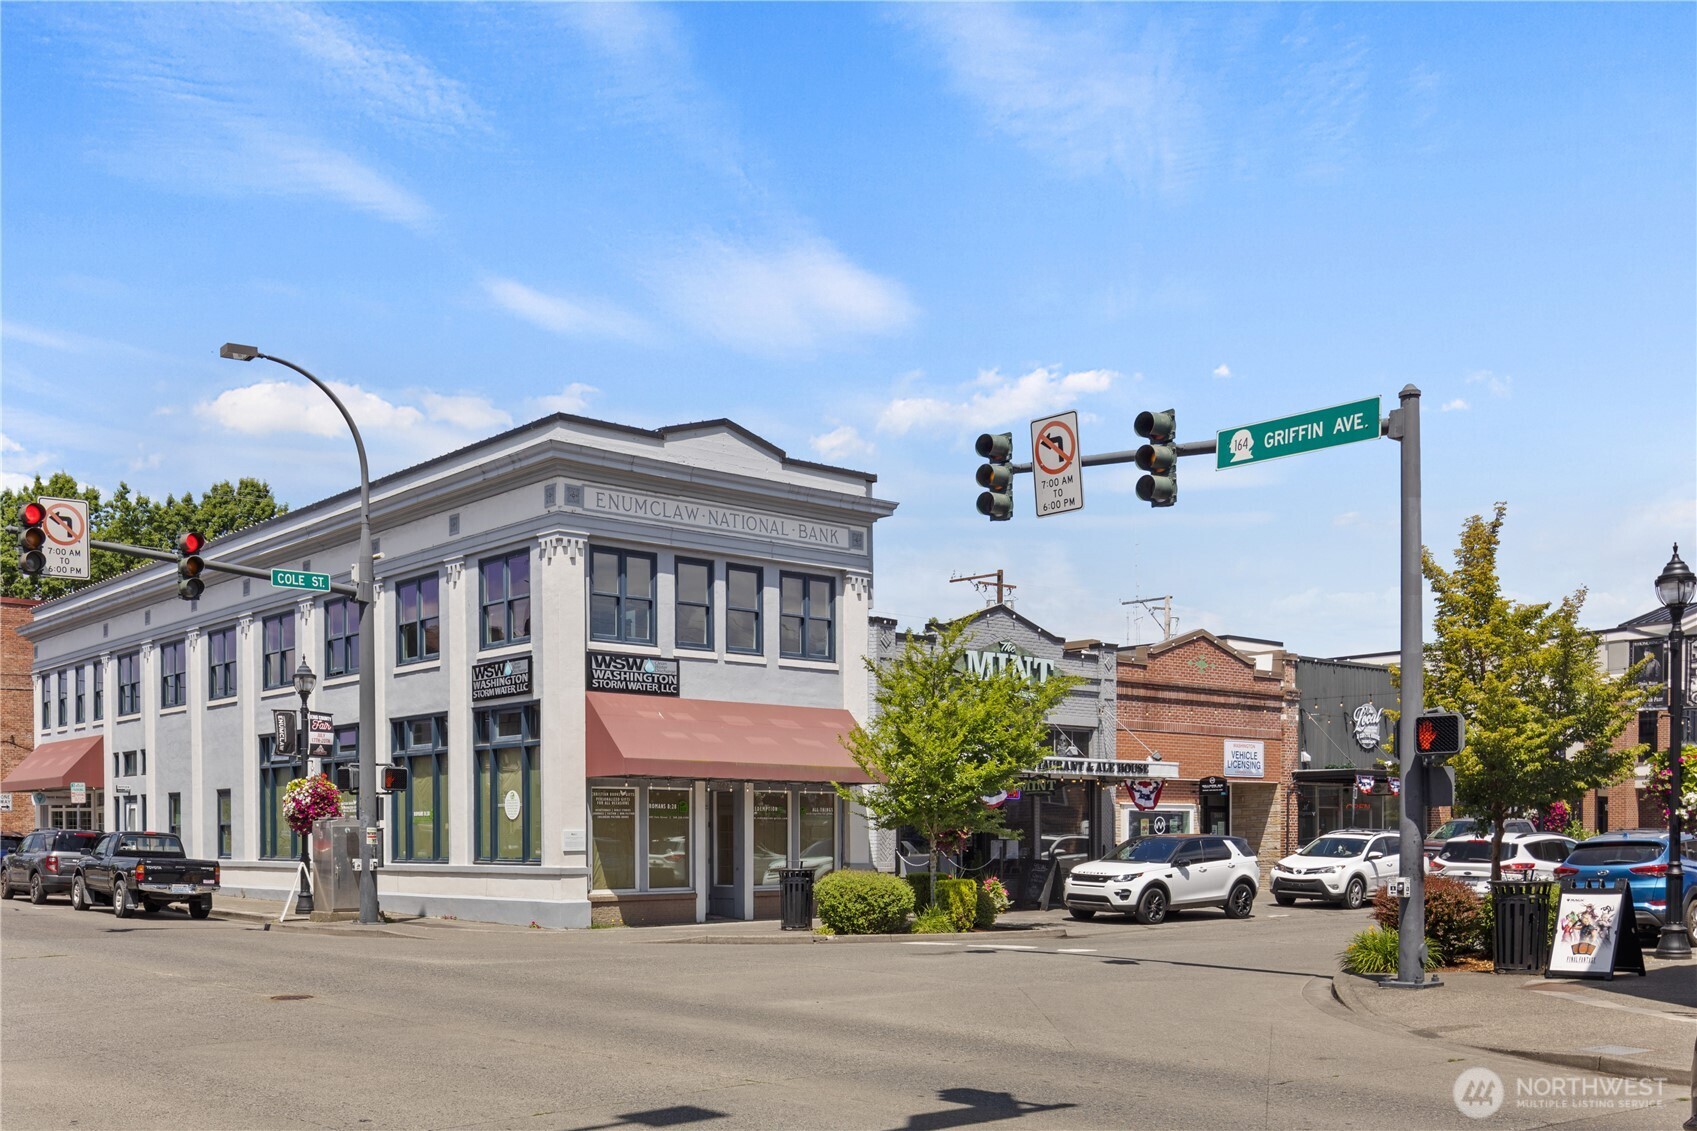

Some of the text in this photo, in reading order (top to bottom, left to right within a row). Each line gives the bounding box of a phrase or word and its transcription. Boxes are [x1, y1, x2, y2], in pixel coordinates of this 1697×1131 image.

[1234, 412, 1369, 451] 164 GRIFFIN AVE.
[1041, 475, 1074, 489] 7:00 AM
[1053, 488, 1063, 498] TO
[1043, 497, 1076, 512] 6:00 PM
[595, 491, 839, 544] ENUMCLAW NATIONAL BANK
[48, 547, 81, 557] 7:00 AM
[60, 557, 70, 565] TO
[70, 566, 82, 574] PM
[277, 573, 325, 588] COLE ST.
[999, 641, 1016, 653] The
[593, 655, 645, 671] WSW
[966, 650, 1055, 687] MINT
[473, 662, 505, 680] WSW
[592, 669, 677, 684] WASHINGTON
[473, 672, 528, 690] WASHINGTON
[592, 679, 677, 693] STORM WATER, LLC
[473, 688, 494, 699] STORM
[517, 682, 528, 692] LLC
[311, 720, 332, 731] Fair
[277, 715, 285, 751] ENUMCLAW
[1231, 751, 1258, 760] VEHICLE
[1086, 763, 1095, 772] &
[1096, 763, 1115, 773] ALE
[1117, 763, 1150, 774] HOUSE
[1227, 760, 1261, 770] LICENSING
